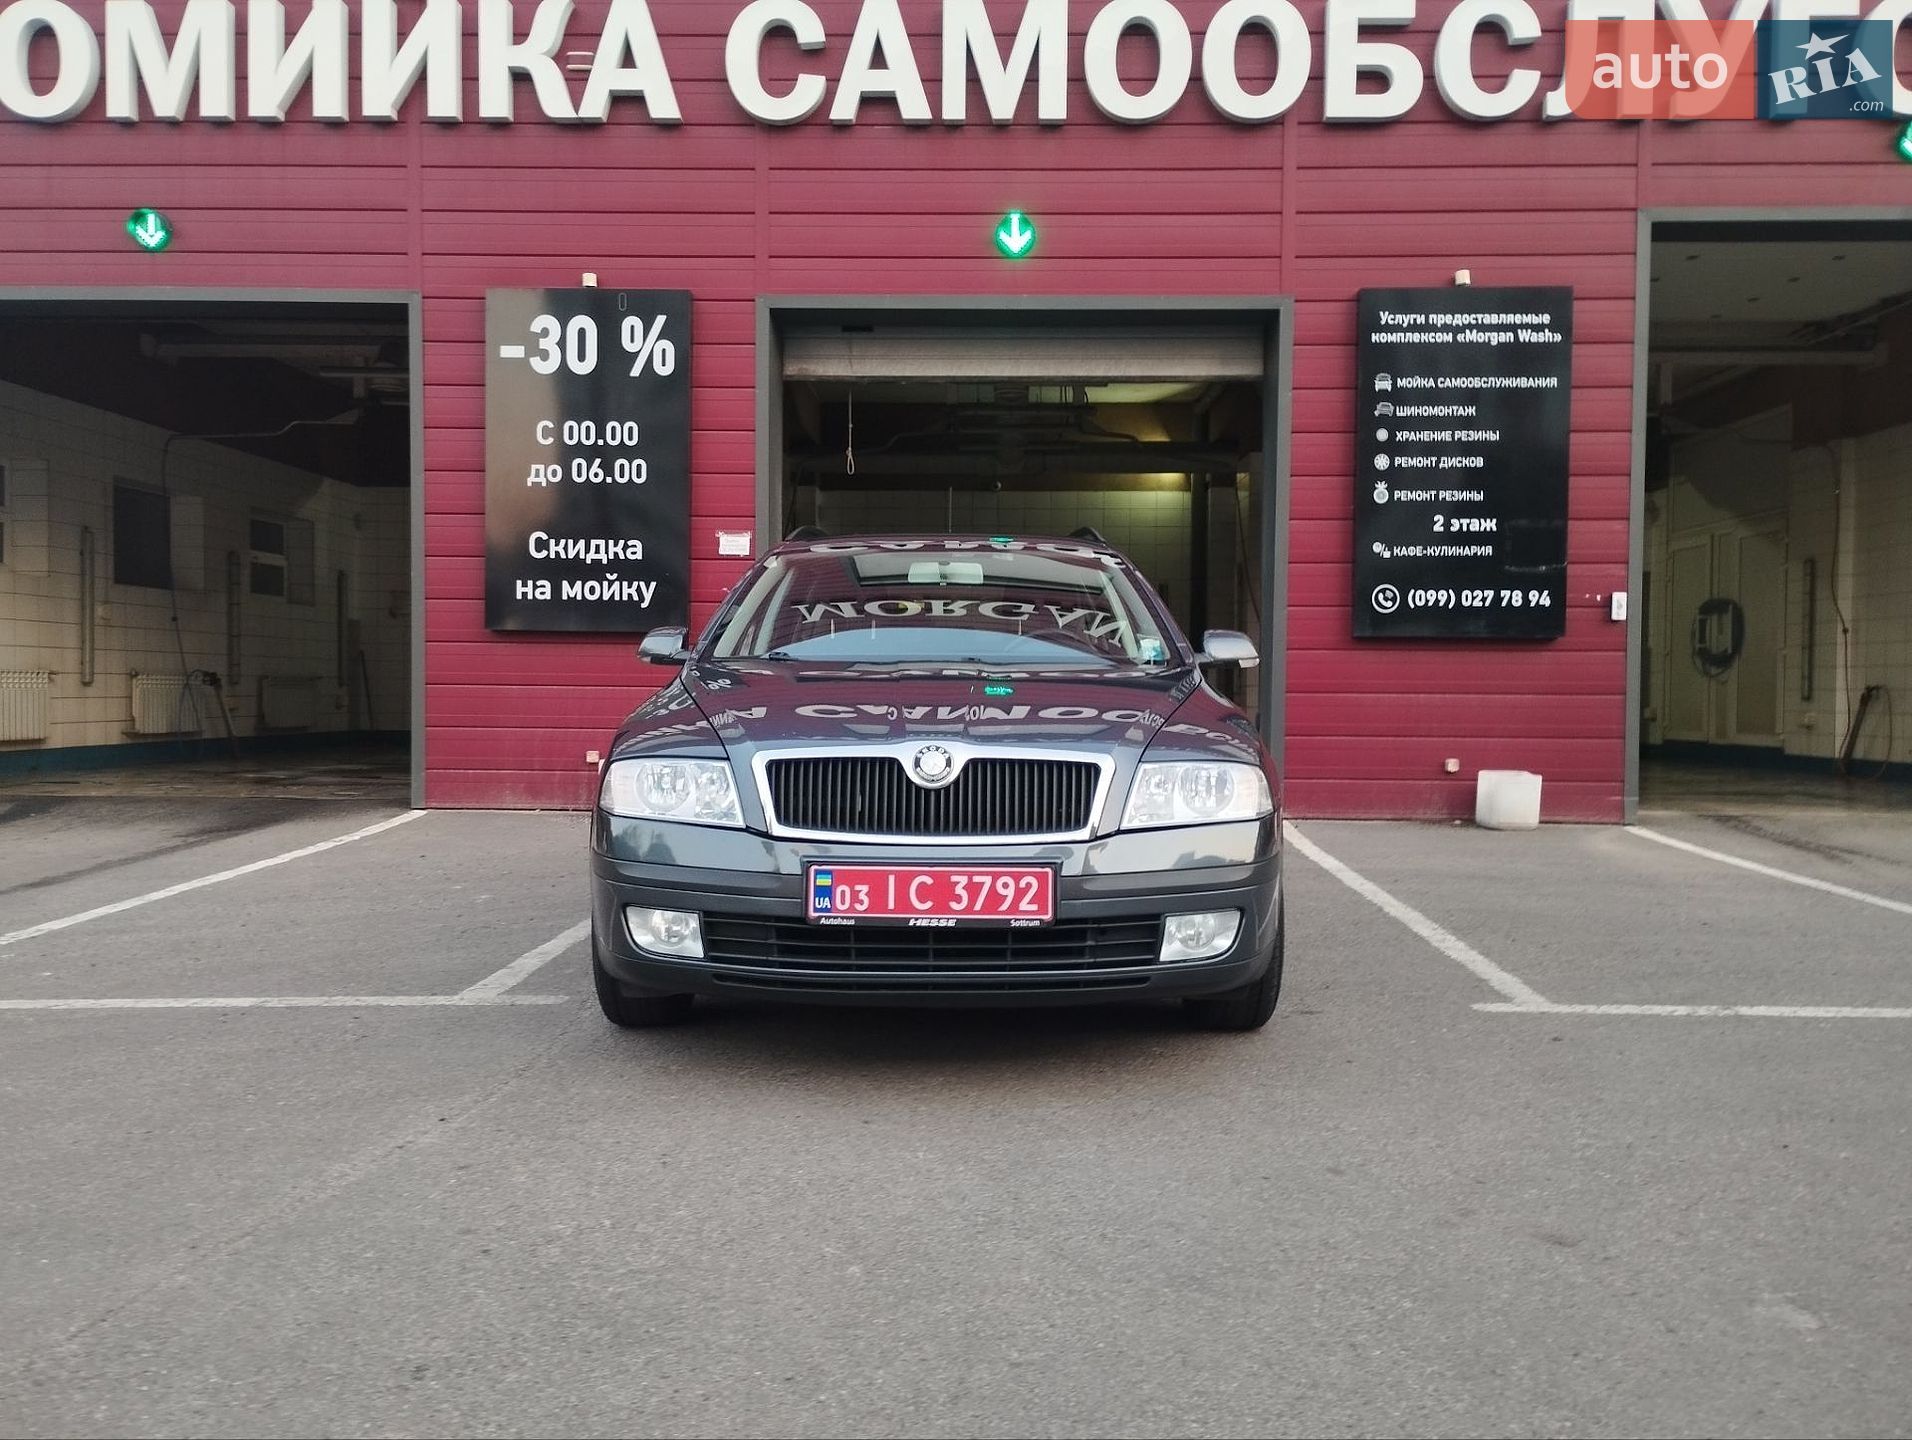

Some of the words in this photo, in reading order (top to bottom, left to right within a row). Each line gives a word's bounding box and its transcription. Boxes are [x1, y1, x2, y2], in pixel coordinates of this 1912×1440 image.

[1380, 311, 1426, 328] Услуги
[1429, 312, 1551, 327] предоставляемые
[1371, 331, 1453, 344] комплексом
[500, 315, 598, 375] -30
[621, 315, 676, 377] %
[1397, 375, 1435, 389] МОЙКА
[1437, 376, 1558, 389] САМООБСЛУЖИВАНИЯ
[1396, 405, 1477, 418] ШИНОМОНТАЖ
[563, 420, 640, 446] 00.00
[1395, 430, 1453, 442] ХРАНЕНИЕ
[1454, 430, 1500, 442] РЕЗИНЫ
[1394, 456, 1437, 469] РЕМОНТ
[1439, 456, 1484, 470] ДИСКОВ
[527, 463, 563, 487] до
[571, 458, 648, 485] 06.00
[1394, 490, 1437, 502] РЕМОНТ
[1438, 490, 1484, 502] РЕЗИНЫ
[1433, 514, 1444, 533] 2
[1449, 516, 1497, 533] этаж
[528, 531, 643, 564] Скидка
[1393, 544, 1493, 558] КАФЕ-КУЛИНАРИЯ
[515, 579, 552, 601] на
[561, 573, 657, 608] мойку
[1407, 589, 1456, 609] (099)
[1461, 590, 1495, 608] 027
[1501, 590, 1523, 608] 78
[1528, 590, 1551, 608] 94
[835, 884, 870, 912] 03
[948, 874, 1040, 912] 3792
[815, 896, 832, 910] UA
[819, 917, 856, 926] Autohaus
